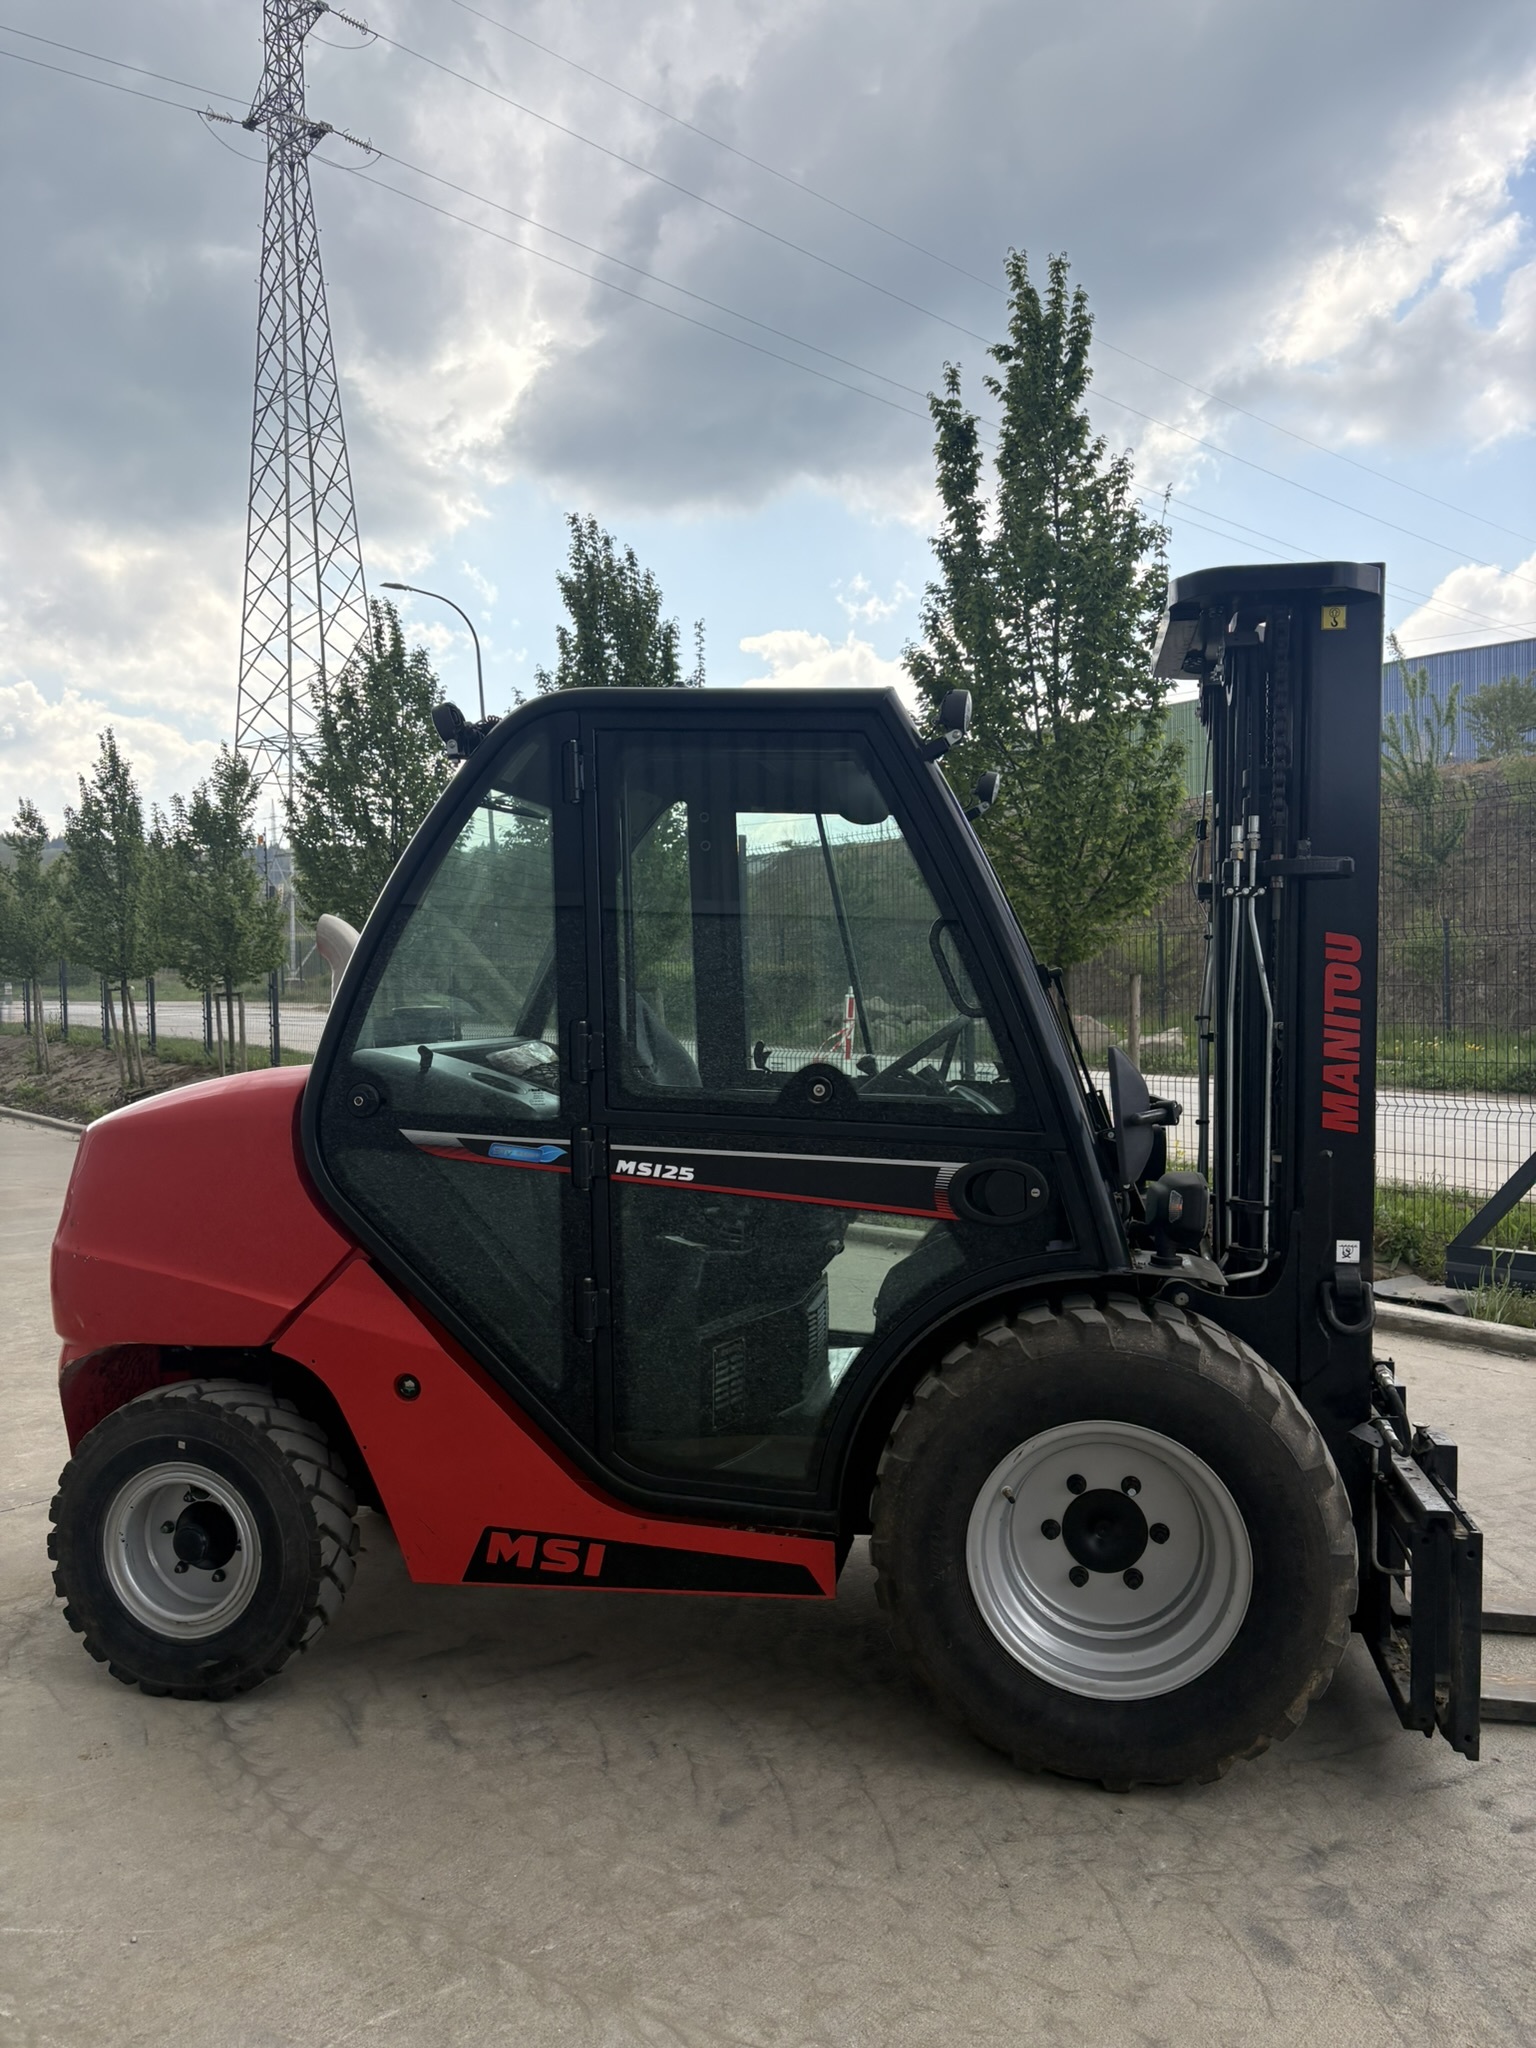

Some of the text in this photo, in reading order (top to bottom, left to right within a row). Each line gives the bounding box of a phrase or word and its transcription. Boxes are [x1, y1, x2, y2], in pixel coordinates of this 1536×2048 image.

[1322, 931, 1362, 1133] MANITOU
[615, 1159, 695, 1181] MSI25
[486, 1531, 606, 1577] MSI
